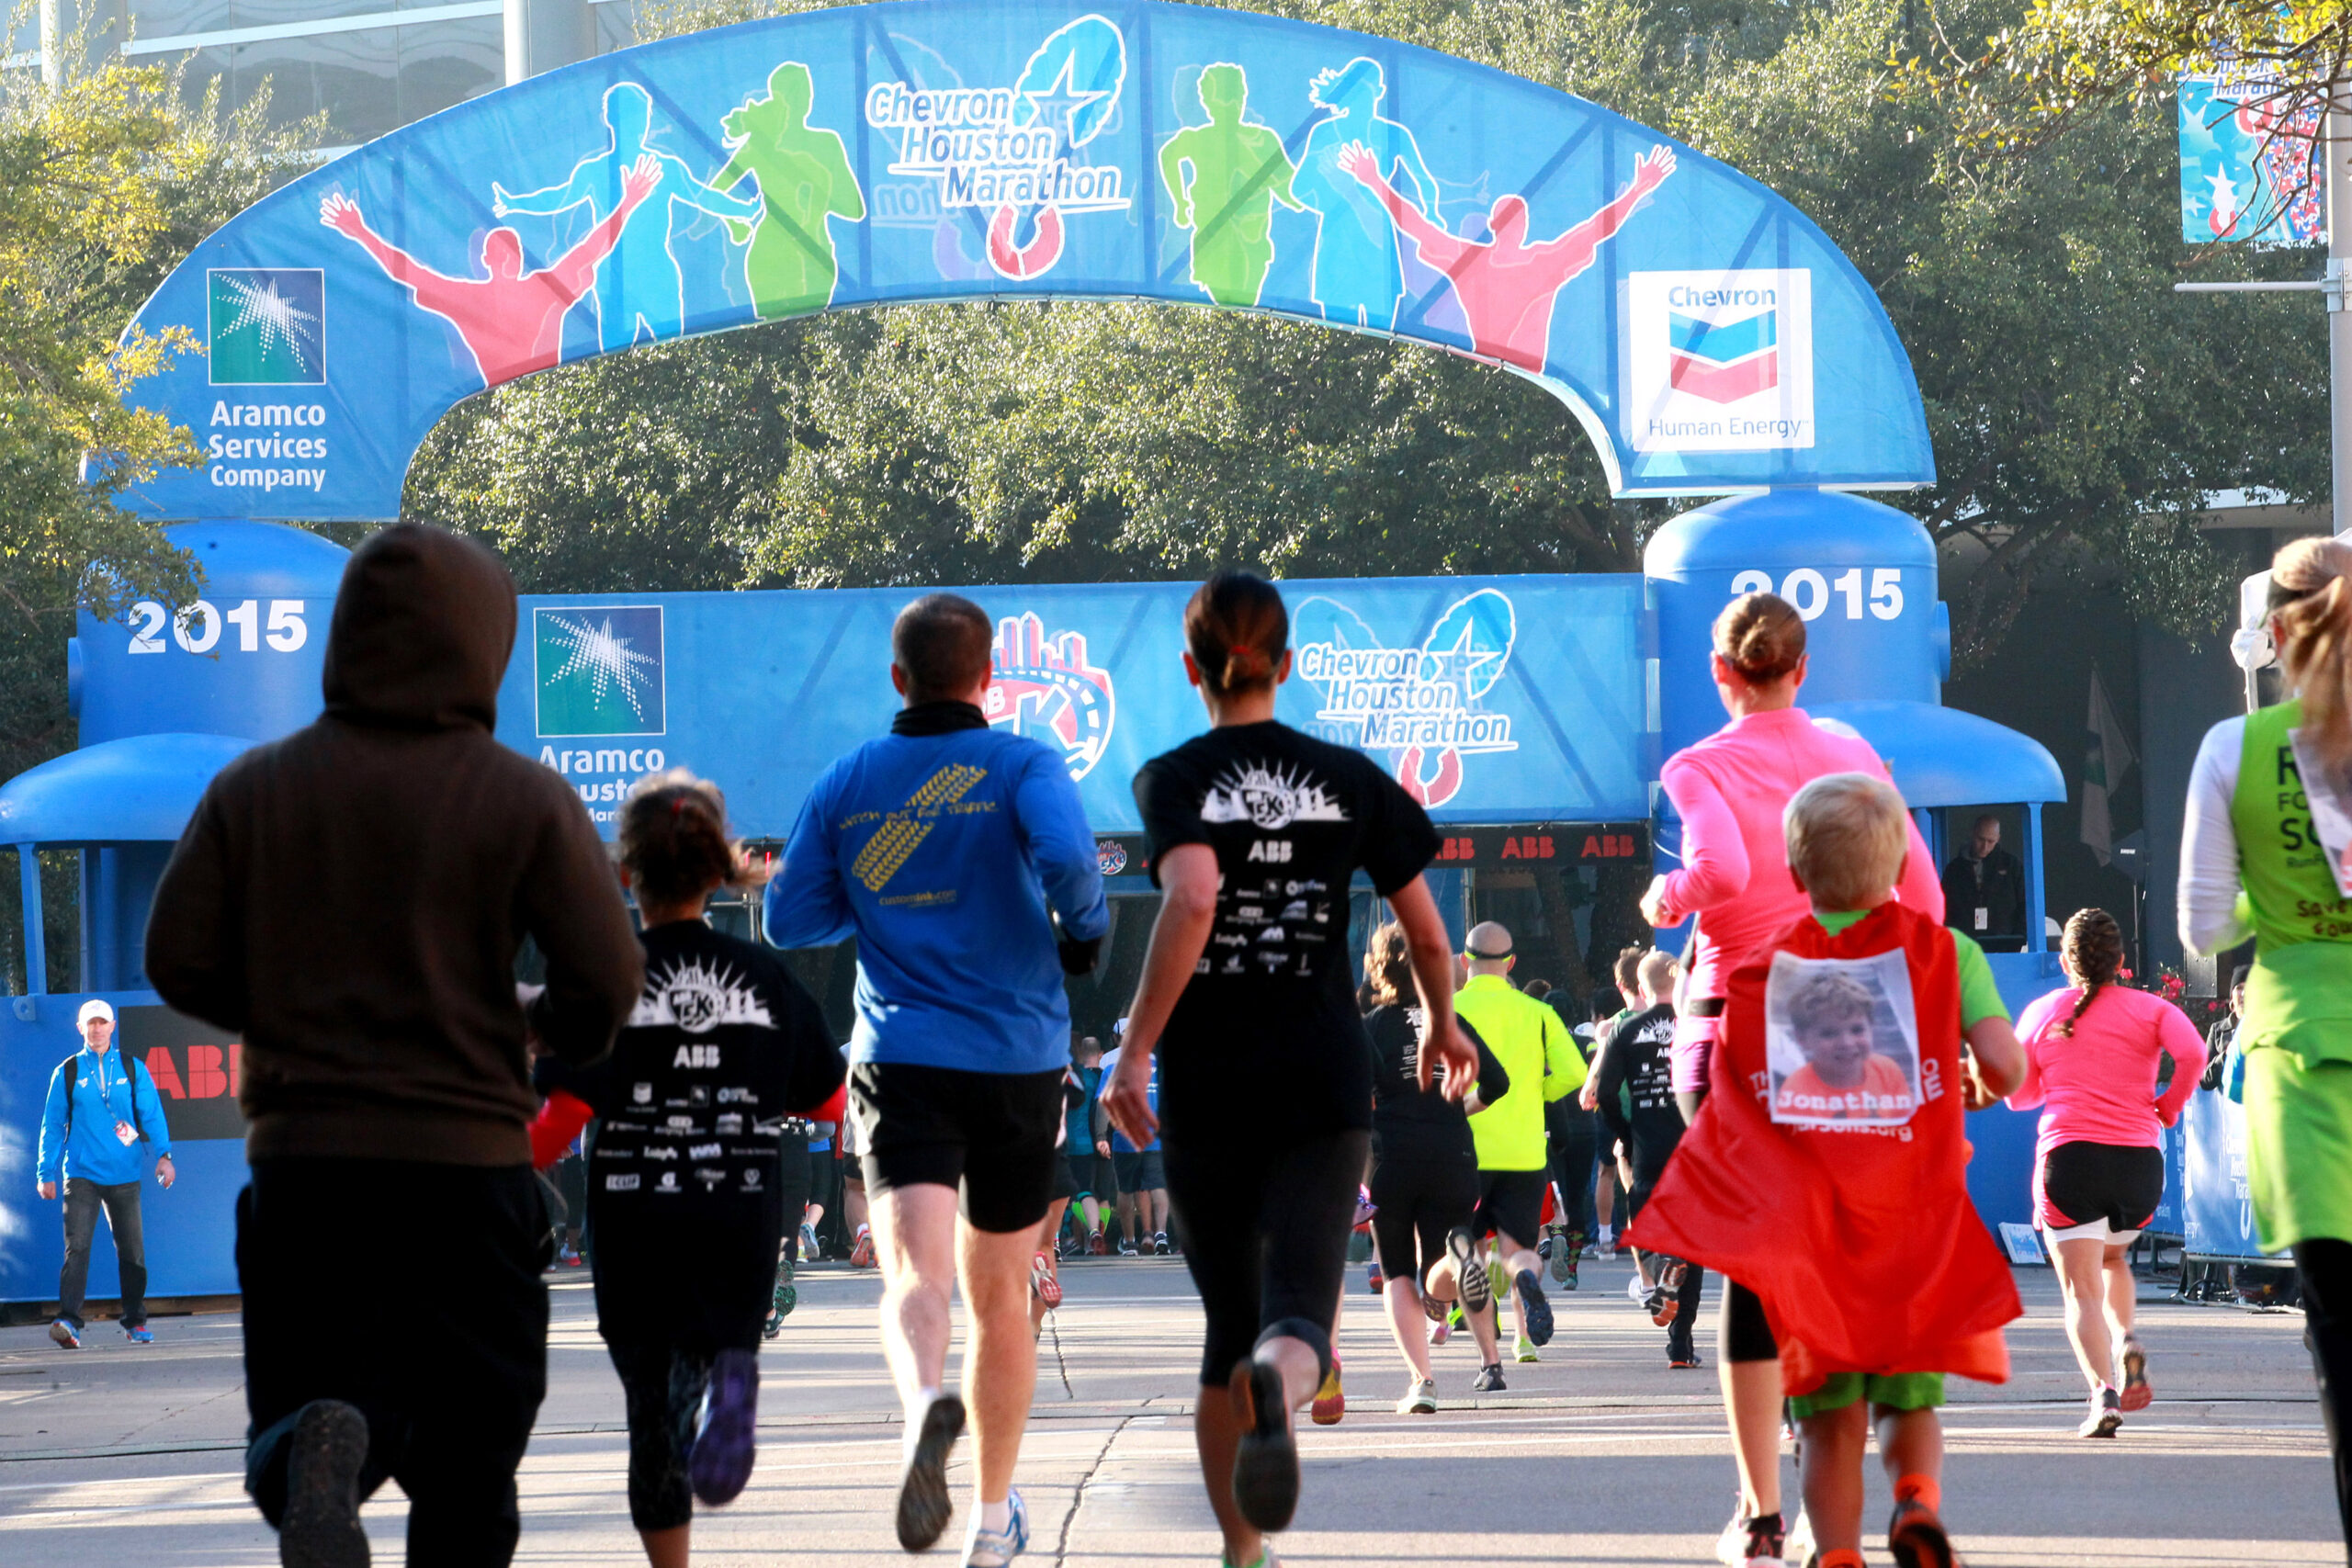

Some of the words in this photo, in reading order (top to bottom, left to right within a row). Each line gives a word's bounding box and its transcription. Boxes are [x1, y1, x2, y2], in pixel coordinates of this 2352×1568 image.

[866, 82, 1014, 127] Chevron
[901, 128, 1056, 164] Houston
[942, 159, 1122, 206] Marathon
[1668, 286, 1776, 308] Chevron
[209, 400, 326, 426] Aramco
[1648, 418, 1722, 436] Human
[1729, 417, 1803, 438] Energy
[209, 432, 327, 459] Services
[210, 465, 326, 492] Company
[129, 600, 308, 654] 2015
[1298, 642, 1423, 681] Chevron
[1327, 681, 1457, 714] Houston
[1361, 707, 1510, 748] Marathon
[539, 745, 665, 773] Aramco
[1248, 840, 1293, 863] ABB
[1500, 836, 1555, 859] ABB
[1581, 835, 1635, 858] ABB
[673, 1045, 720, 1068] ABB
[1777, 1091, 1912, 1111] Jonathan
